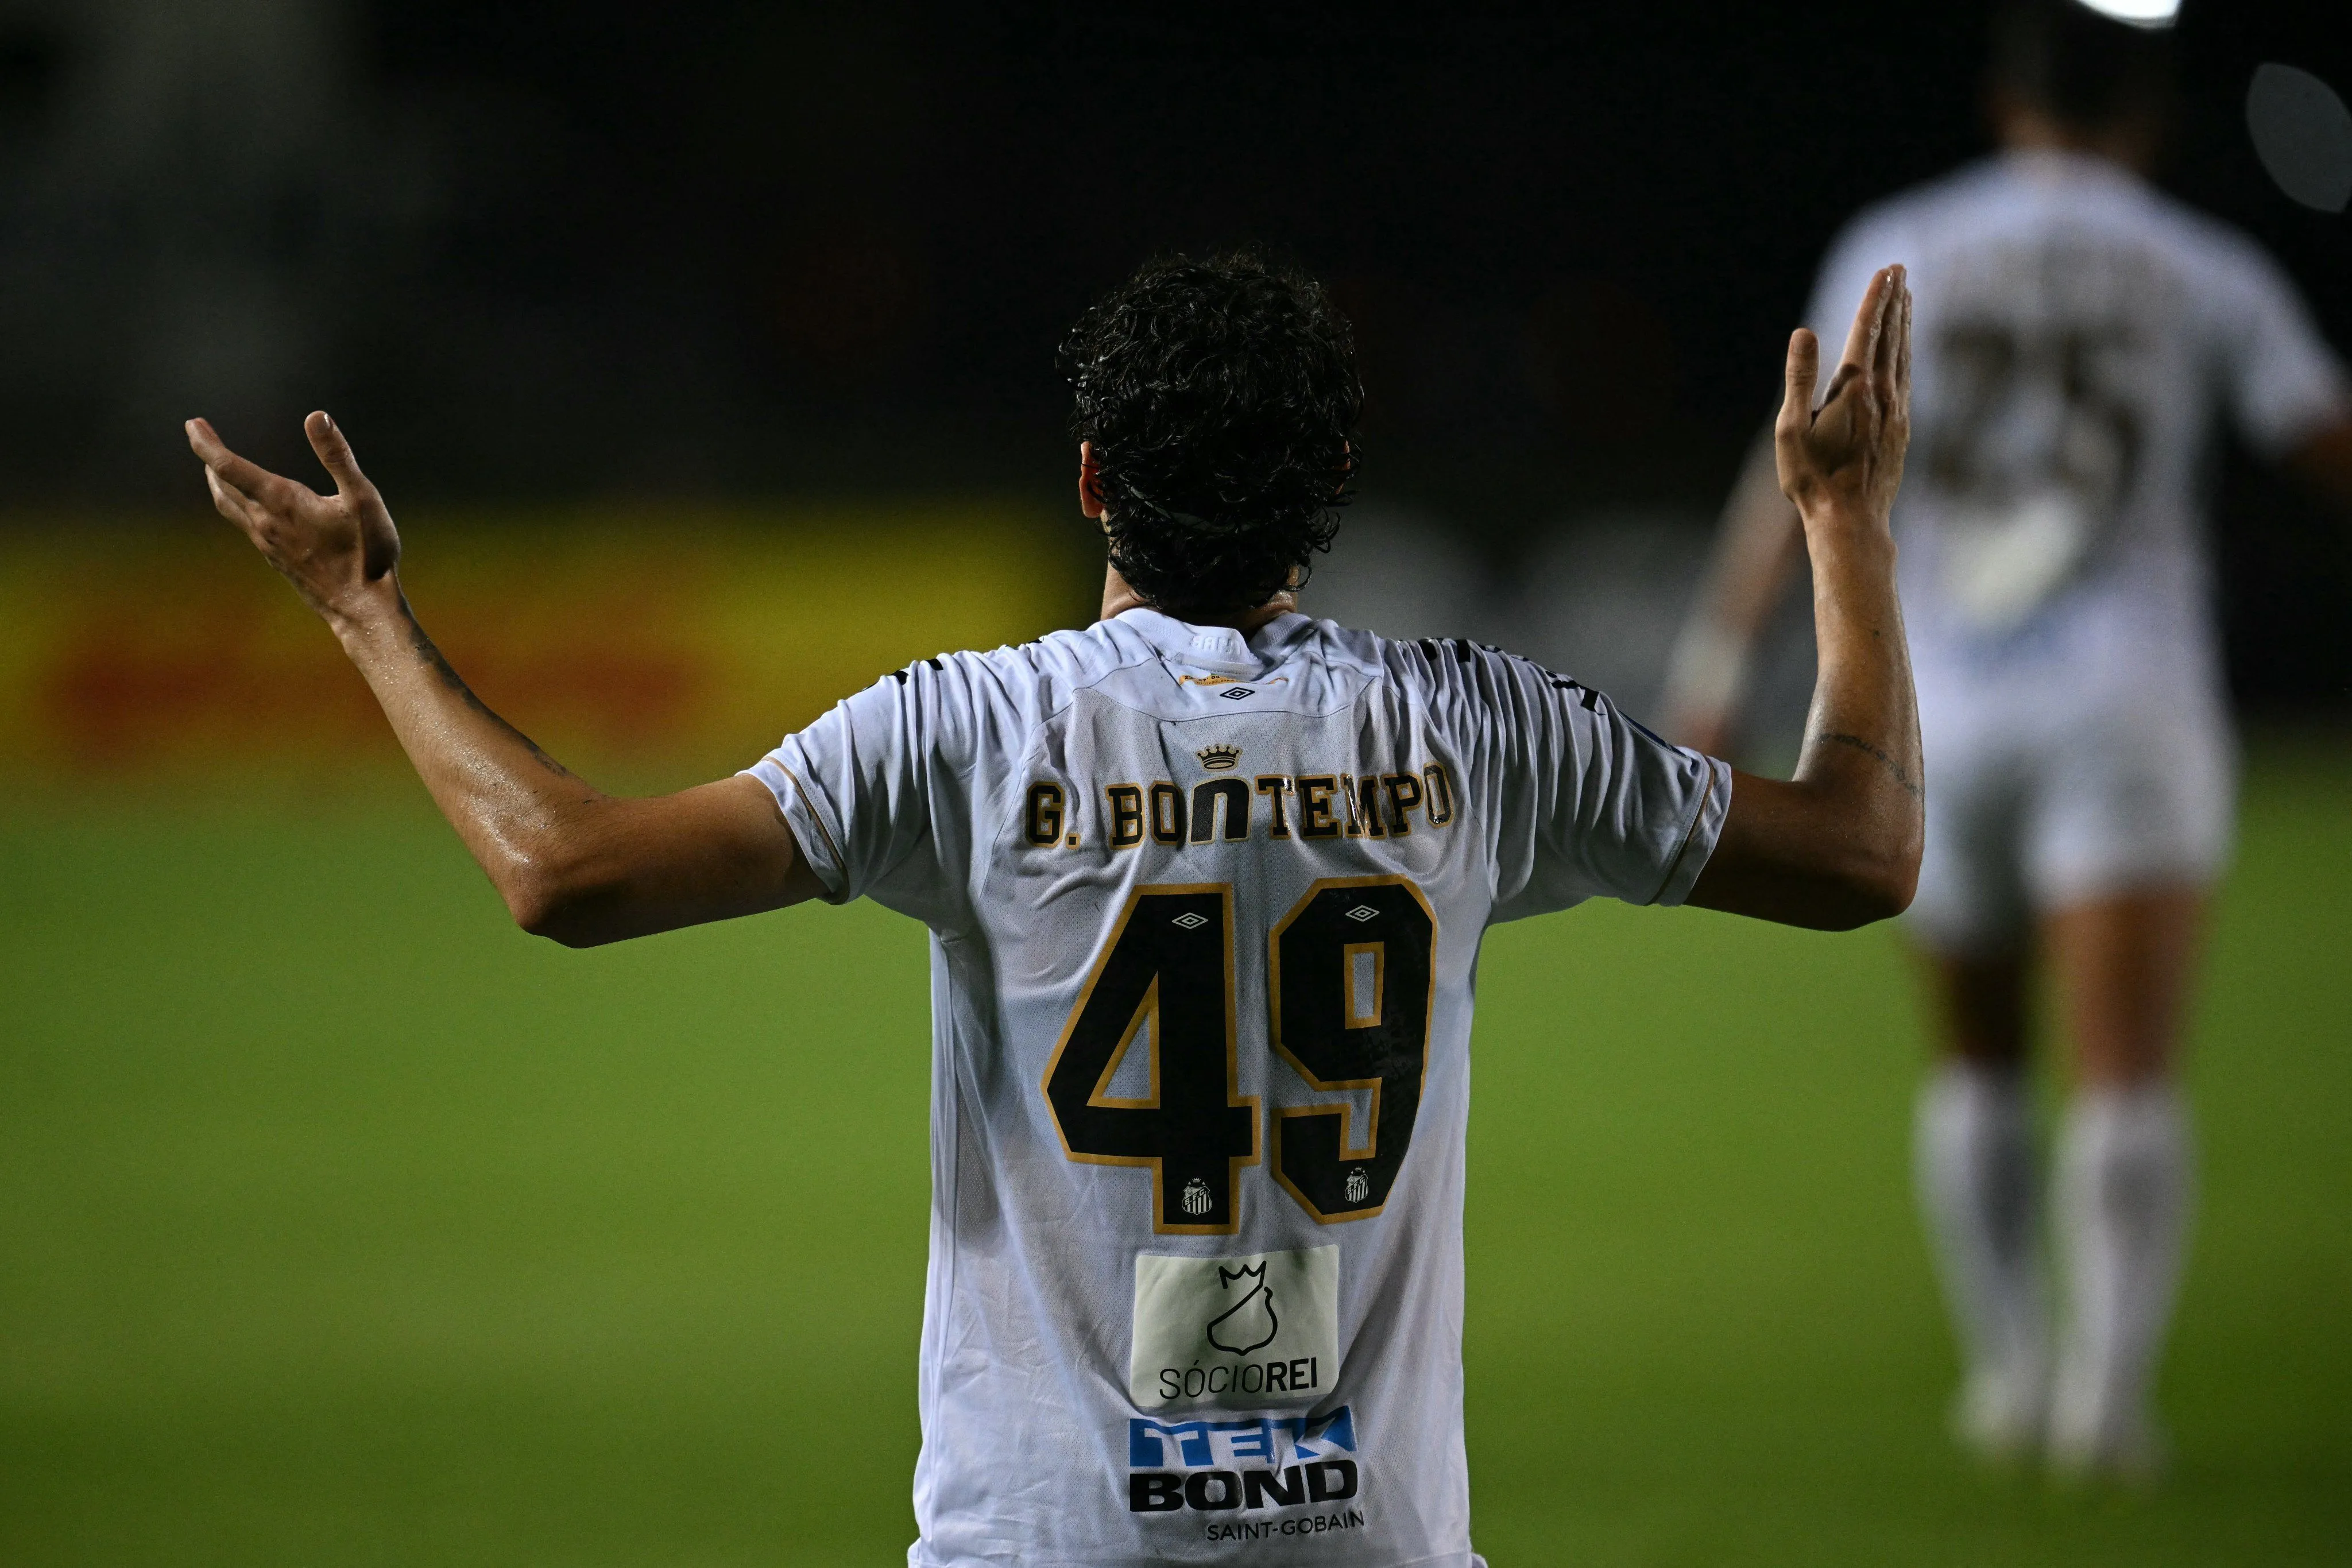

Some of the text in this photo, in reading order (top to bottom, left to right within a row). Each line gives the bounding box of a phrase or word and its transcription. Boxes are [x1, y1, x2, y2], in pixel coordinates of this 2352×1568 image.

[1026, 781, 1081, 850] G.
[1040, 874, 1437, 1236] 49
[1159, 1357, 1317, 1400] SÓCIOREI
[1129, 1405, 1357, 1467] TEK
[1129, 1459, 1358, 1512] BOND
[1206, 1510, 1365, 1542] SAINT-GOBAIN
